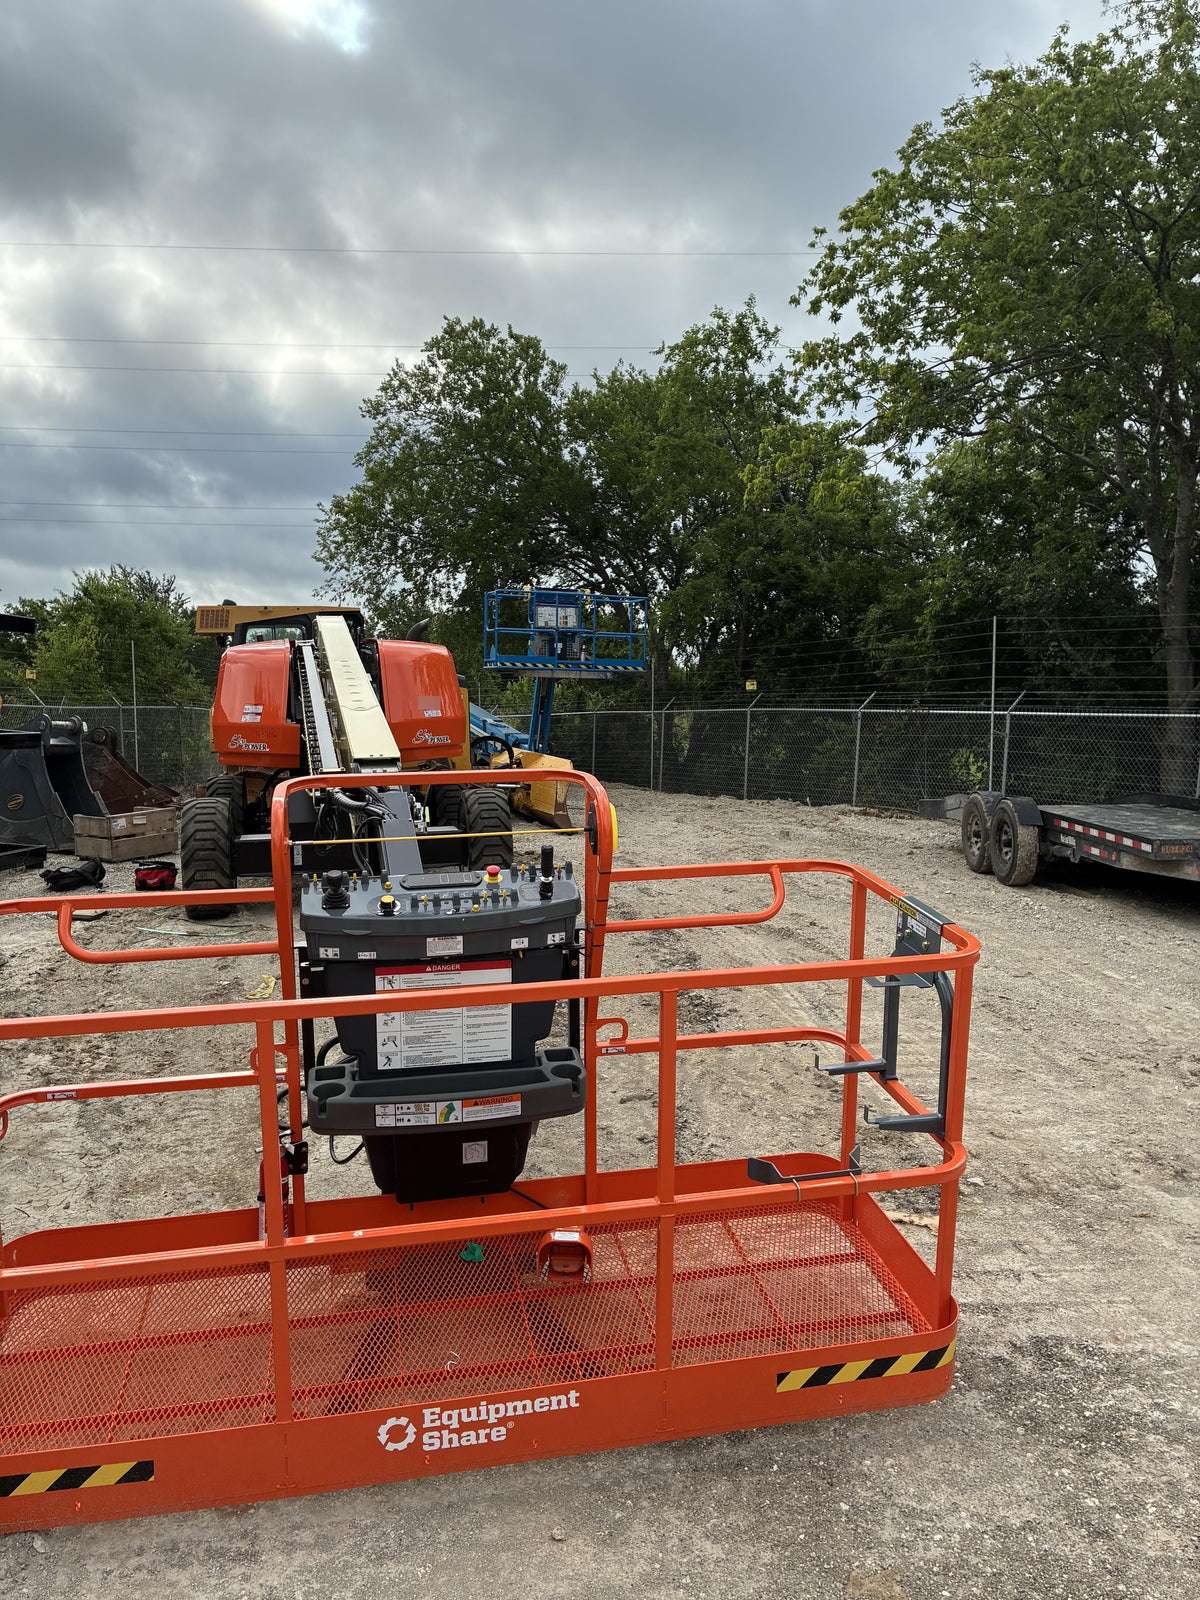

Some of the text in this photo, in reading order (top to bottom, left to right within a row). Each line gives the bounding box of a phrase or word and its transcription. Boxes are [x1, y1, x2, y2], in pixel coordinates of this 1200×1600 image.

[228, 734, 246, 749] Sky
[243, 743, 269, 751] POWER
[432, 964, 461, 972] DANGER
[478, 1095, 514, 1106] WARNING
[422, 1390, 580, 1429] Equipment
[422, 1425, 507, 1451] Share
